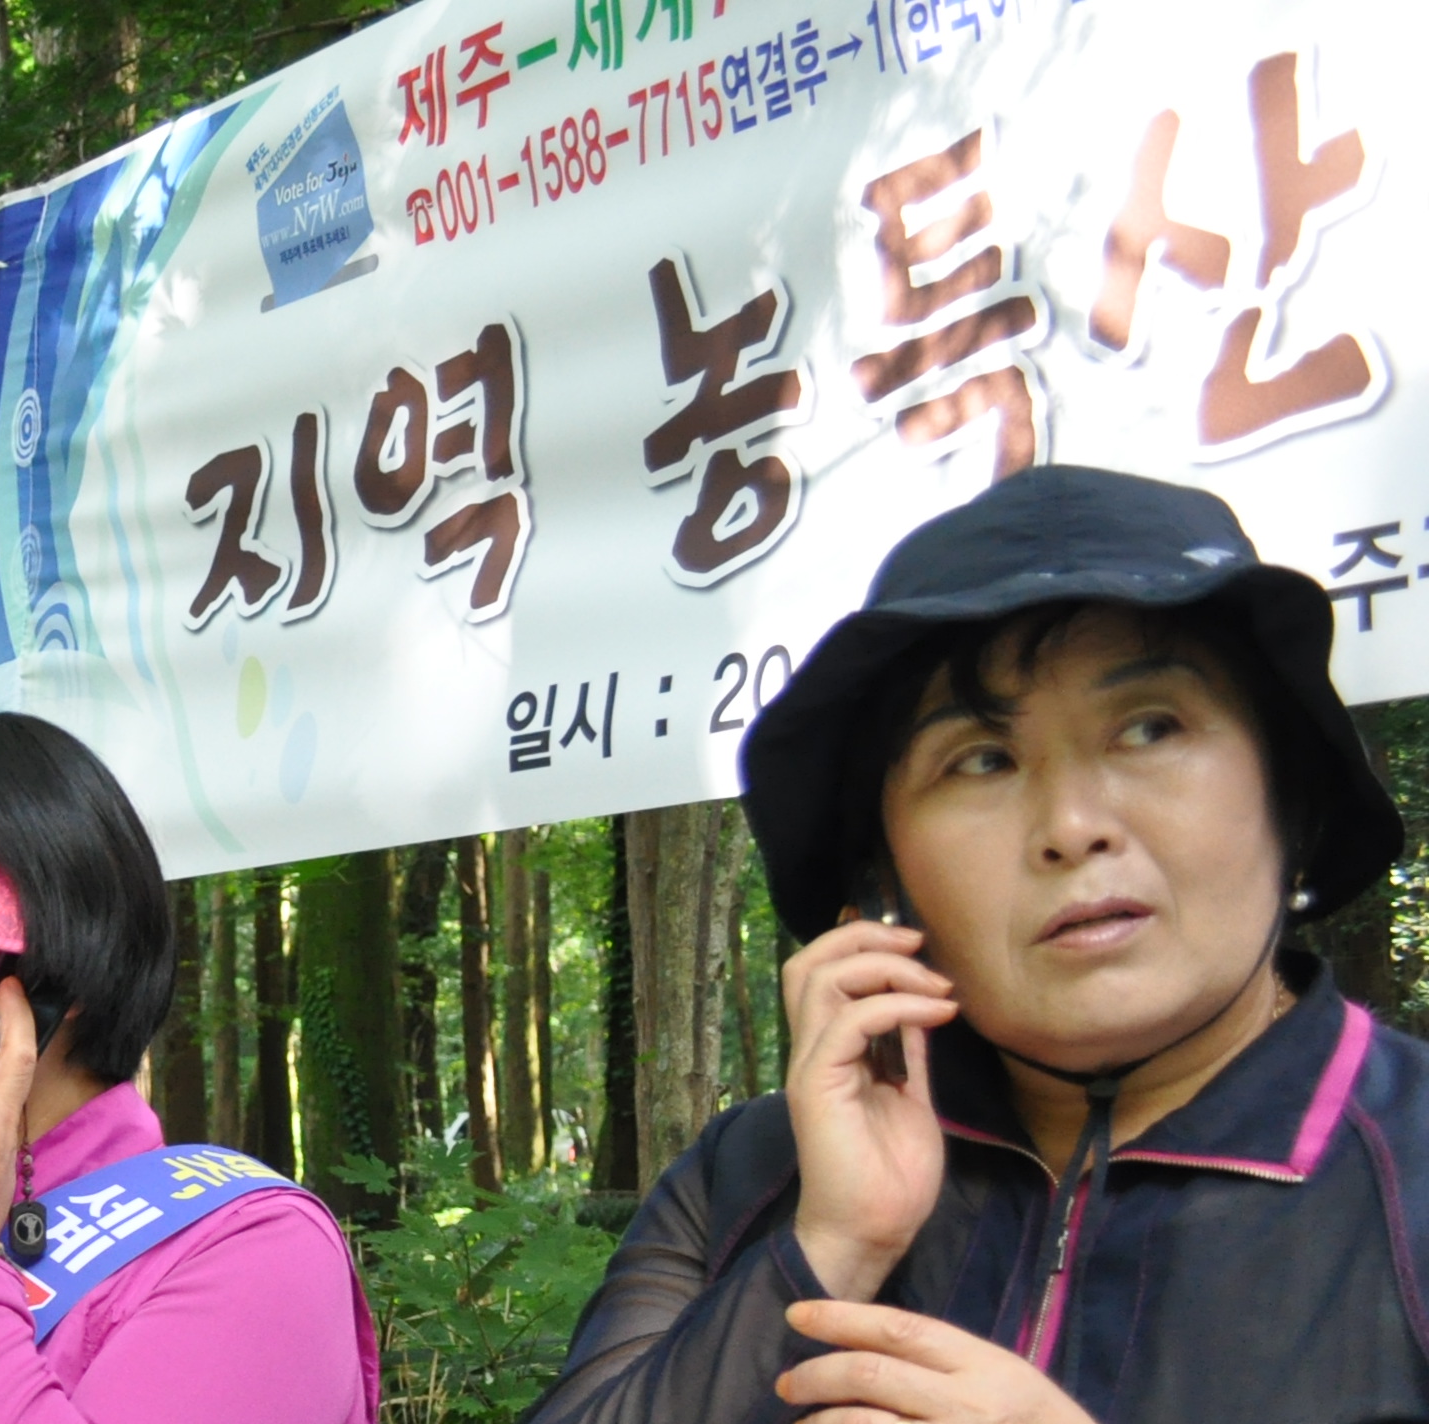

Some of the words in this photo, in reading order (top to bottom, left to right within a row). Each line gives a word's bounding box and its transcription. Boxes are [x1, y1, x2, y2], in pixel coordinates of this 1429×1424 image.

[261, 188, 365, 249] www.N7W.com
[275, 181, 304, 206] Vote
[306, 171, 326, 191] for
[326, 152, 359, 187] Jeju
[187, 320, 523, 621] 지역
[1324, 515, 1429, 633] 주
[507, 671, 619, 773] 일시
